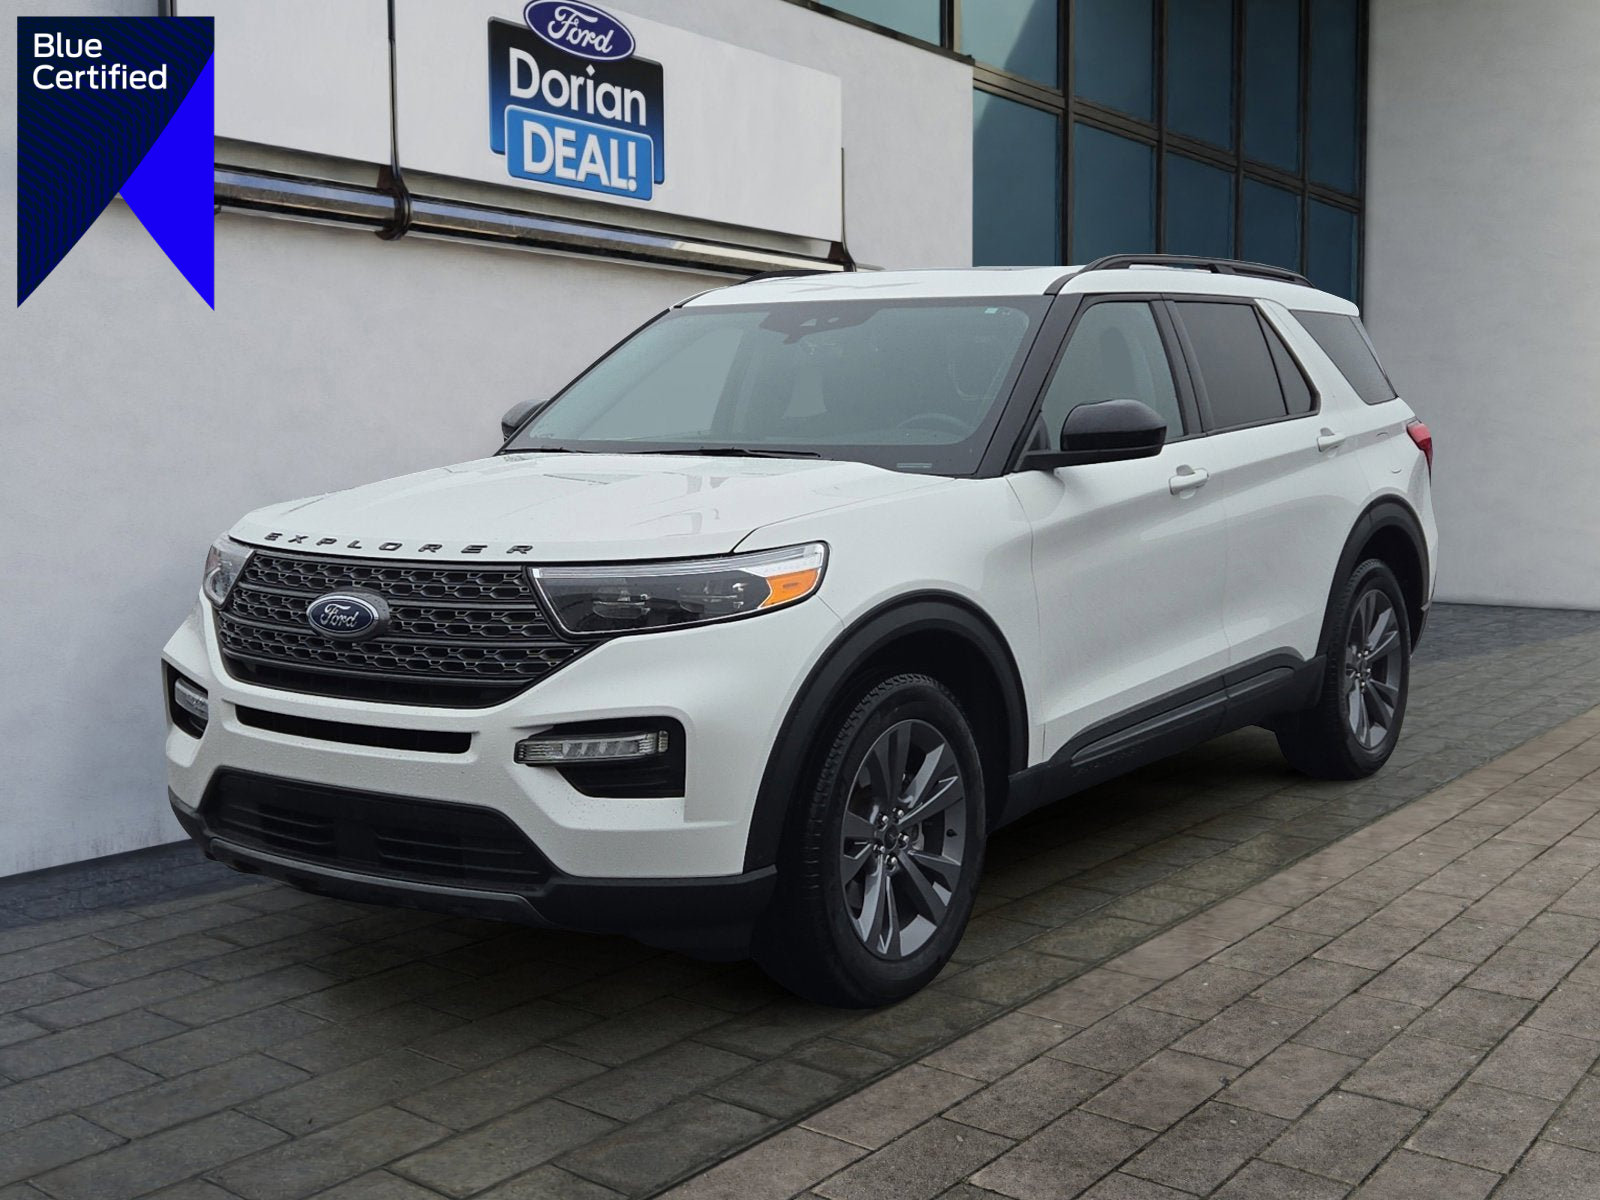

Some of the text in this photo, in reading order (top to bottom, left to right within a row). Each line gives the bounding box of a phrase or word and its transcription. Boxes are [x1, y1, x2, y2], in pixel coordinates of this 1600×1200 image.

[547, 6, 614, 53] Ford
[509, 47, 647, 126] Dorian
[523, 120, 637, 192] DEAL!
[264, 532, 533, 554] EXPLORER
[320, 603, 357, 628] Ford
